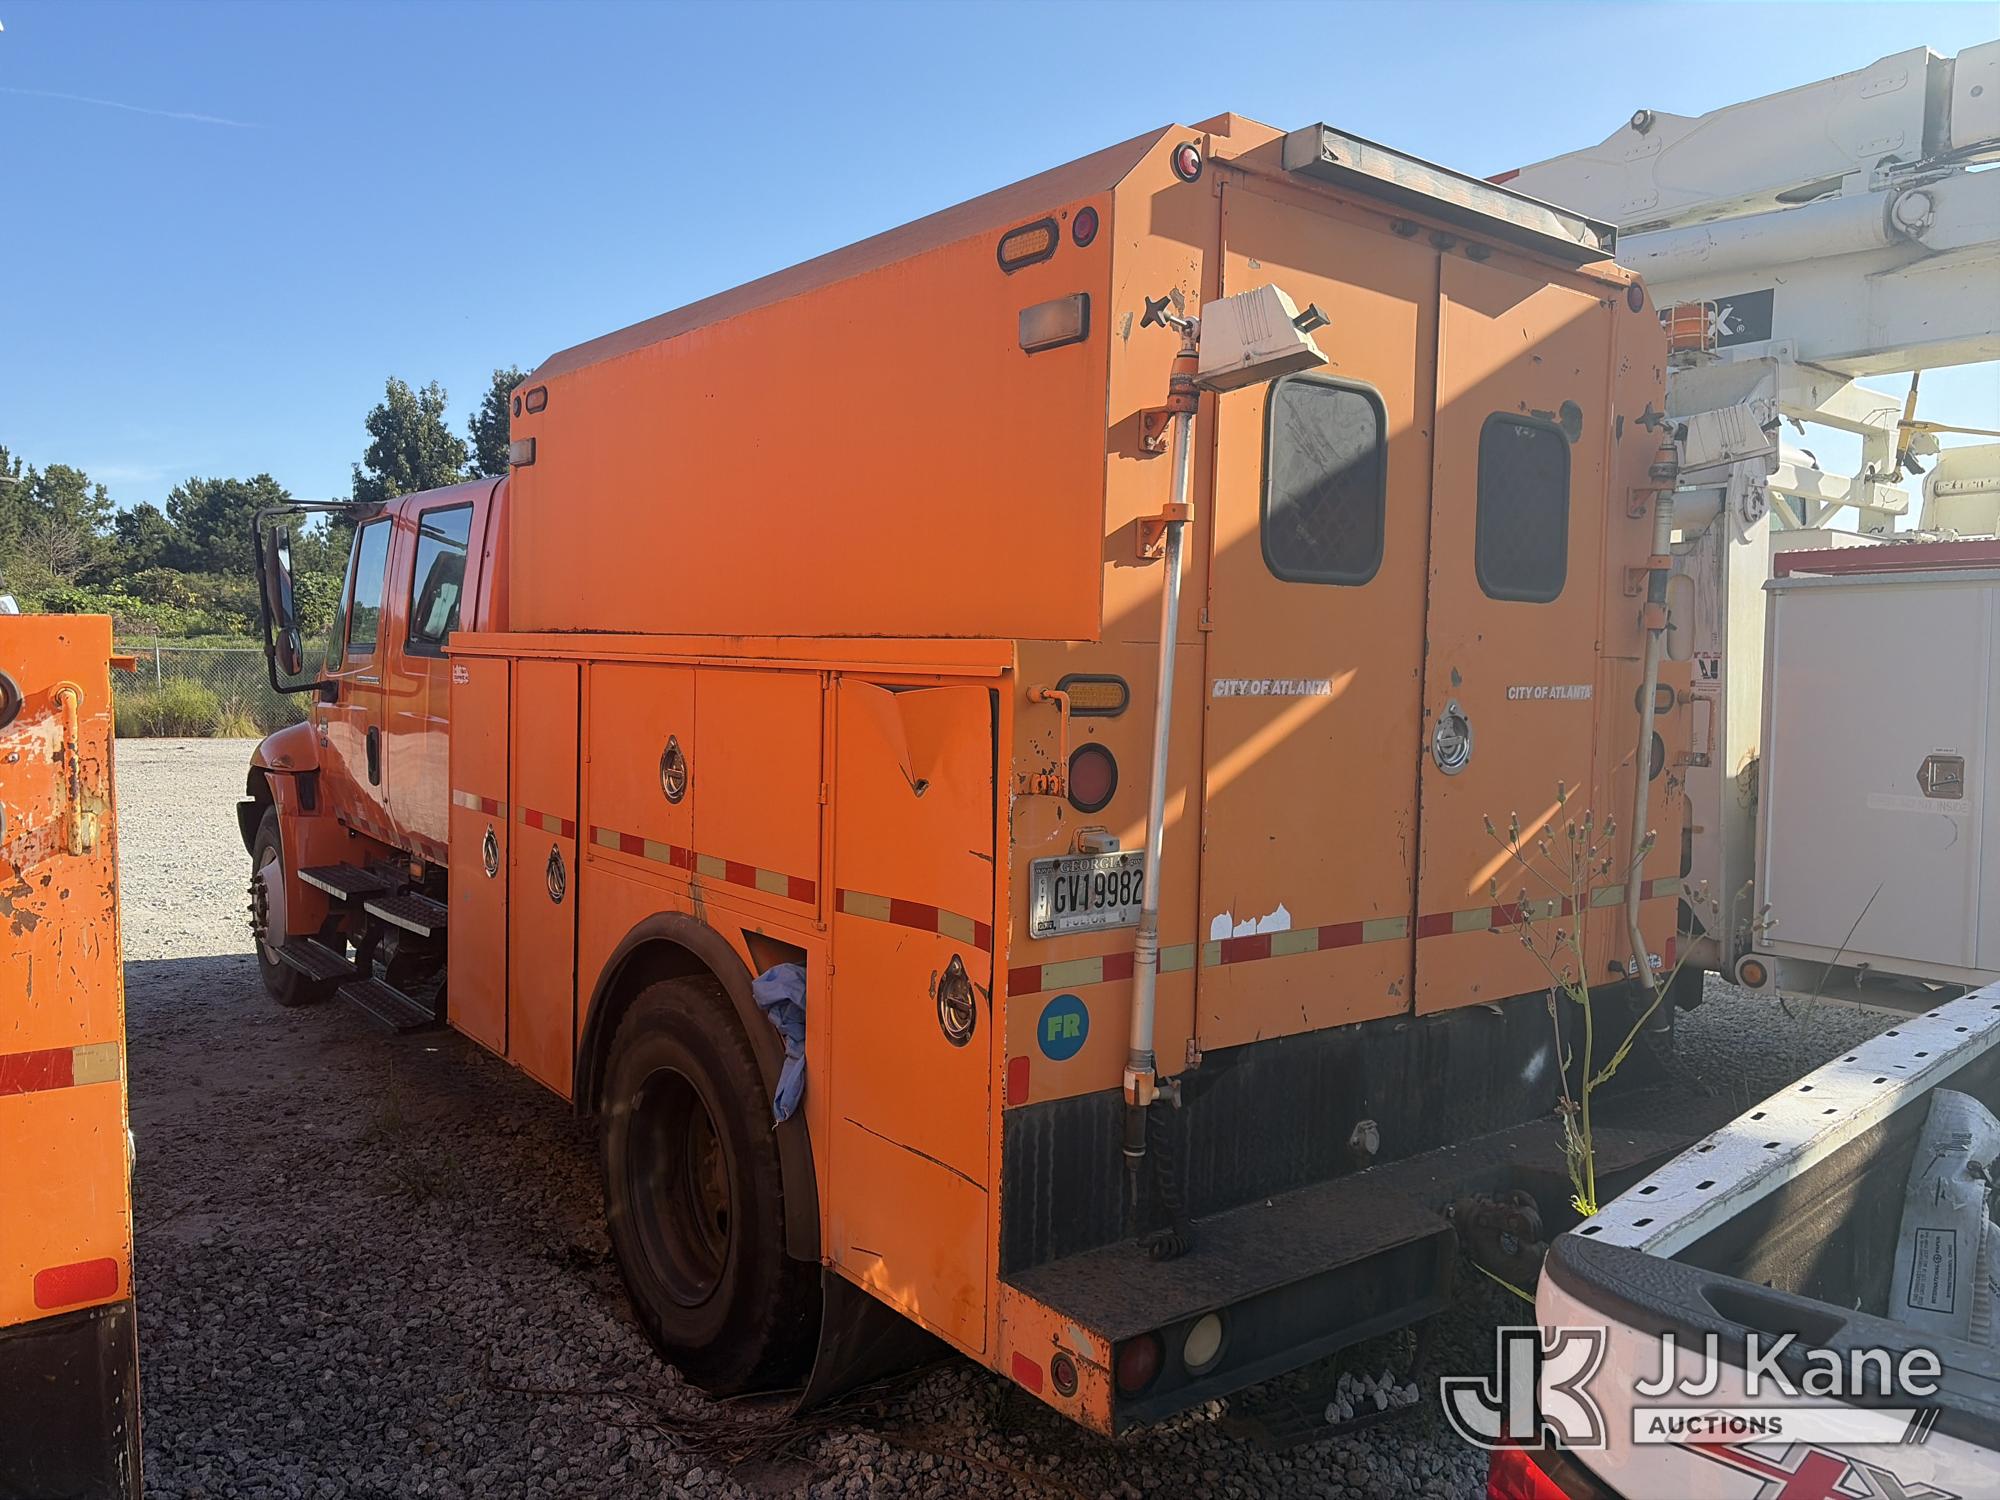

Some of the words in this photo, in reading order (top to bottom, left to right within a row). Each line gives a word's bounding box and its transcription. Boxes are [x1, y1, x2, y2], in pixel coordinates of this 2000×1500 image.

[1214, 679, 1248, 696] CITY
[1250, 680, 1271, 695] OF
[1271, 680, 1331, 695] ATLANTA
[1508, 686, 1533, 699] CITY
[1534, 686, 1548, 698] OF
[1549, 685, 1590, 698] ATLANTA
[1060, 857, 1123, 873] GEORGIA
[1054, 869, 1144, 914] GV19982
[1047, 1013, 1080, 1041] FR
